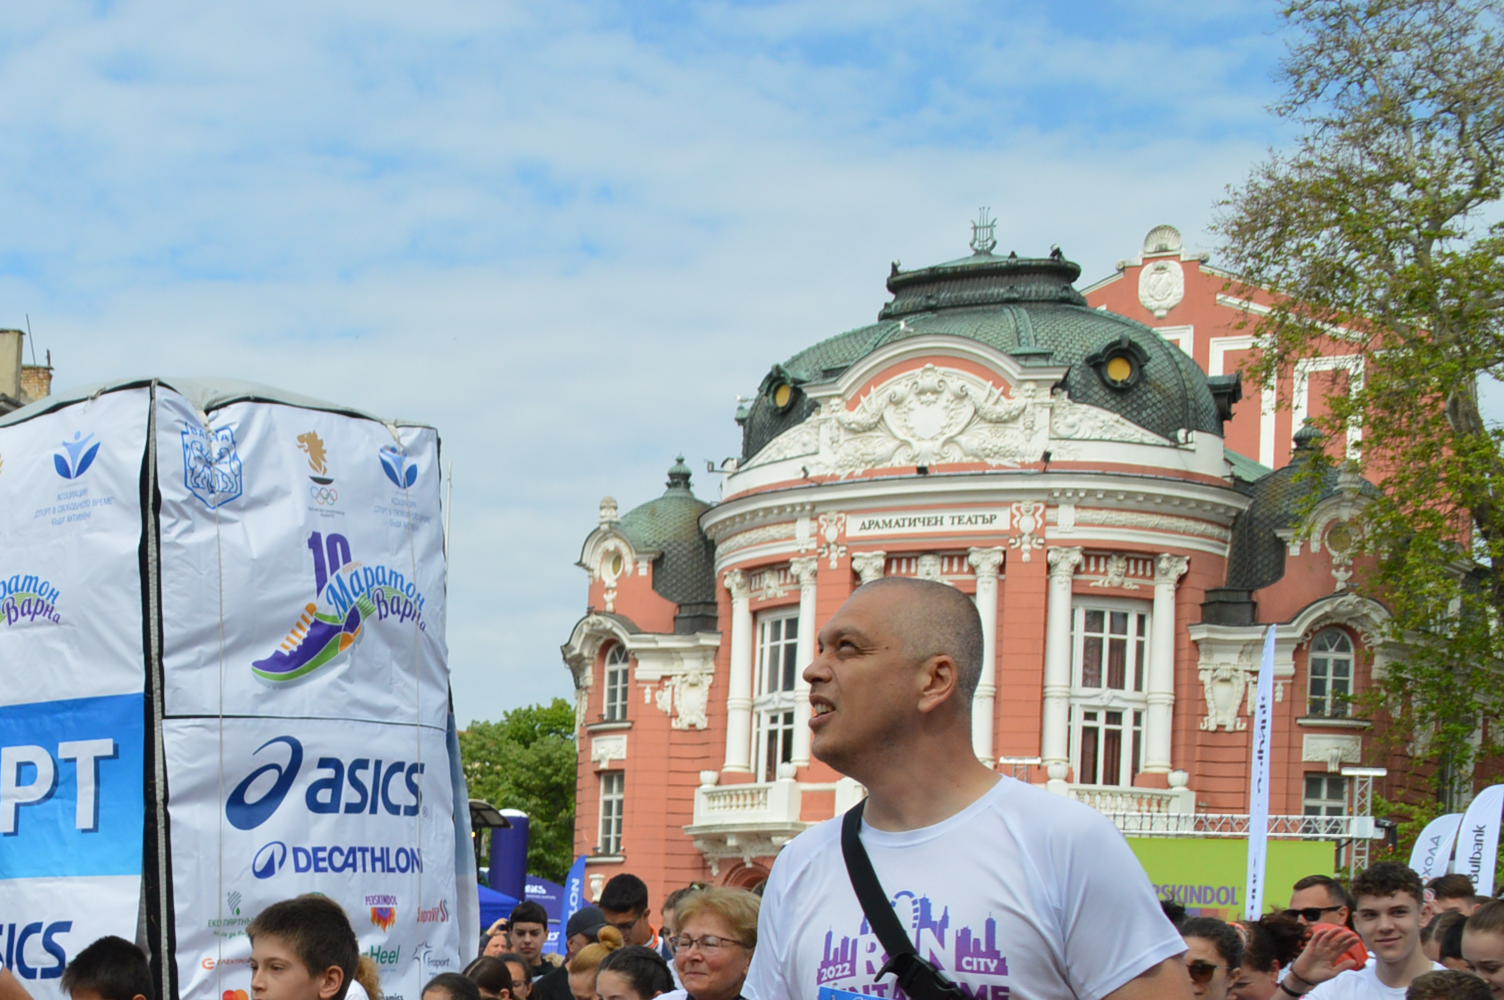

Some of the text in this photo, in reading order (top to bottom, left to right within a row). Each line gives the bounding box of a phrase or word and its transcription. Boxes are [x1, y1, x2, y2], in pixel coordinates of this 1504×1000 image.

[859, 514, 997, 530] ДРАМАТИЧЕН ТЕАТЪР
[307, 531, 352, 599] 10
[326, 565, 425, 620] Маратон
[2, 596, 61, 627] Варна
[371, 588, 426, 632] Варна
[292, 846, 423, 874] DECATHLON
[821, 956, 998, 981] 2022 CITY
